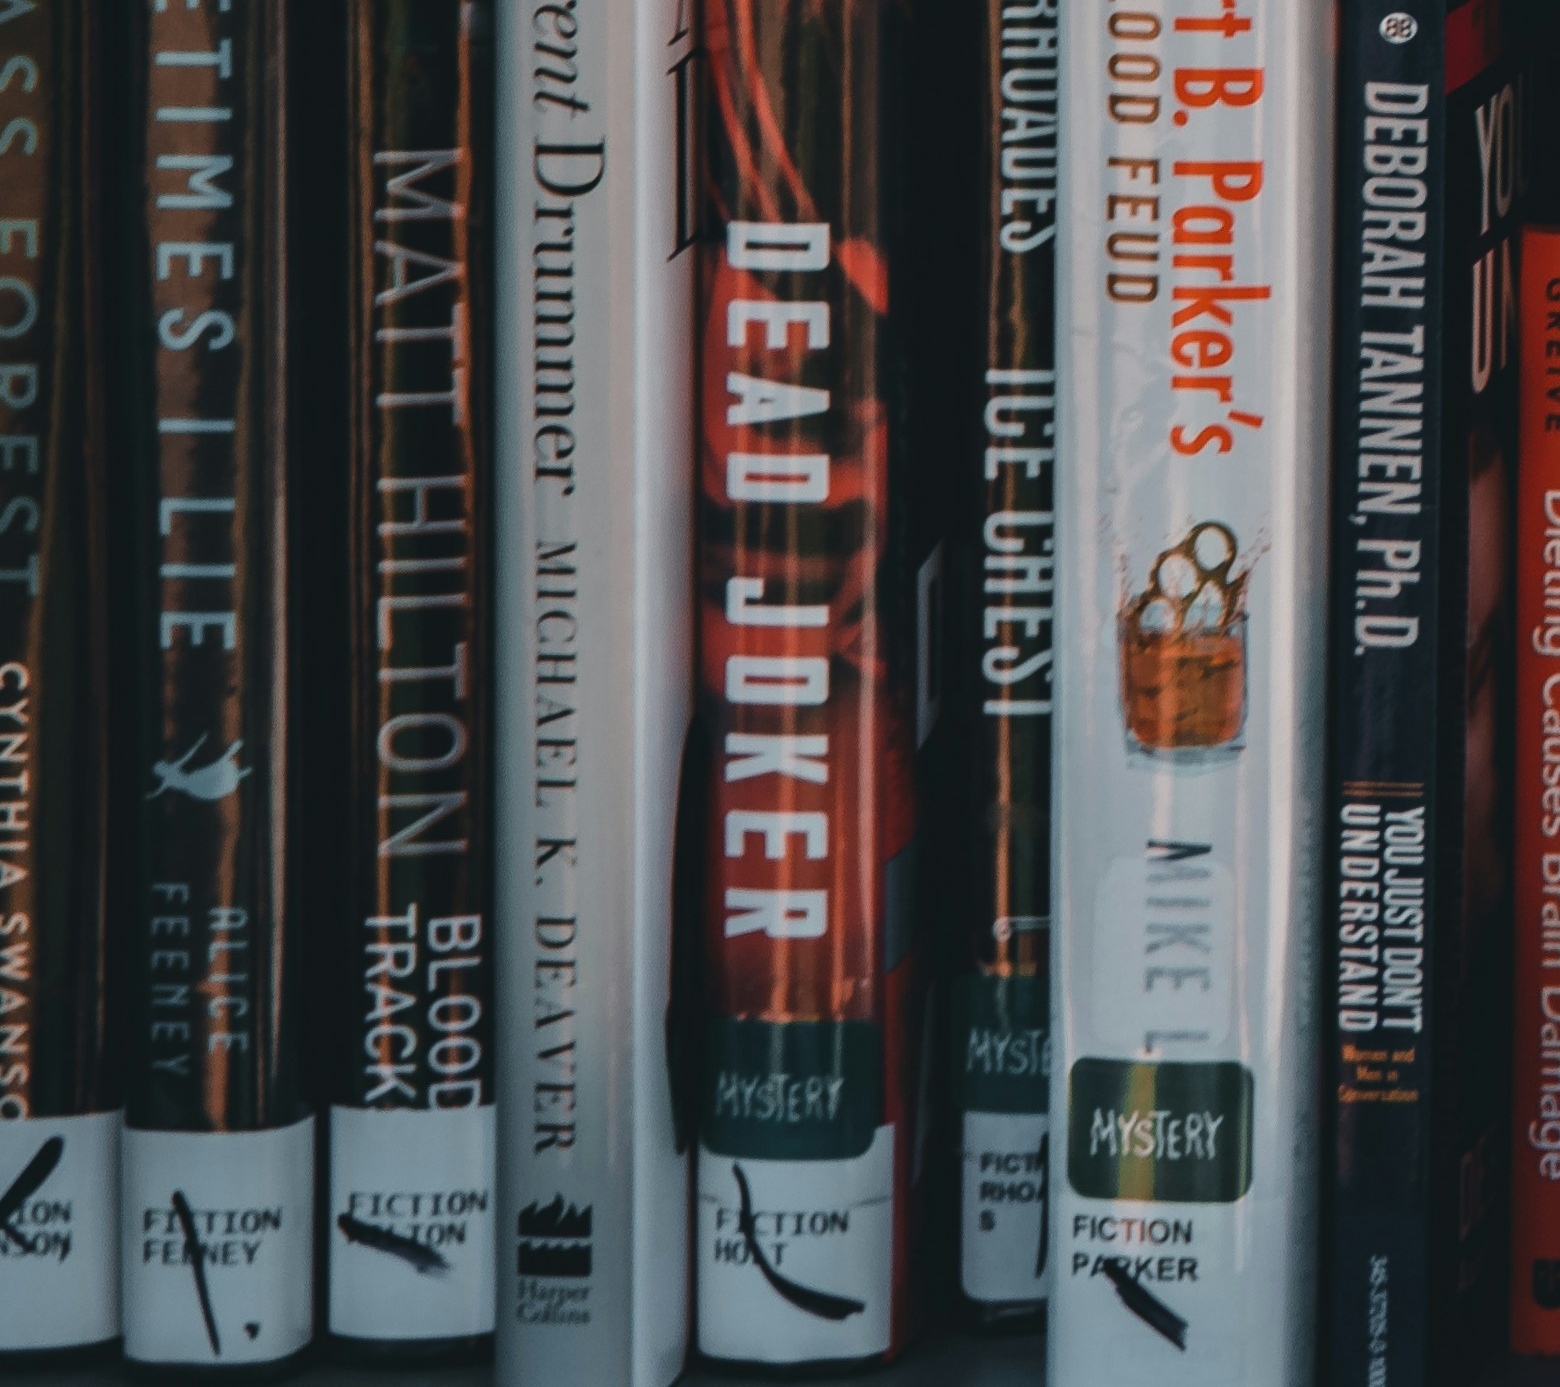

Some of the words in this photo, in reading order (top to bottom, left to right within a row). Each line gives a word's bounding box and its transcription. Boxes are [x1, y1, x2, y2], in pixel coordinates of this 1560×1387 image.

[1106, 155, 1162, 304] FEUD
[1172, 68, 1265, 128] B.
[531, 134, 608, 495] Drummer
[725, 220, 832, 505] DEAD
[1171, 159, 1272, 458] Parker's
[723, 578, 830, 940] JOKER
[1089, 1107, 1224, 1160] MYSTERY
